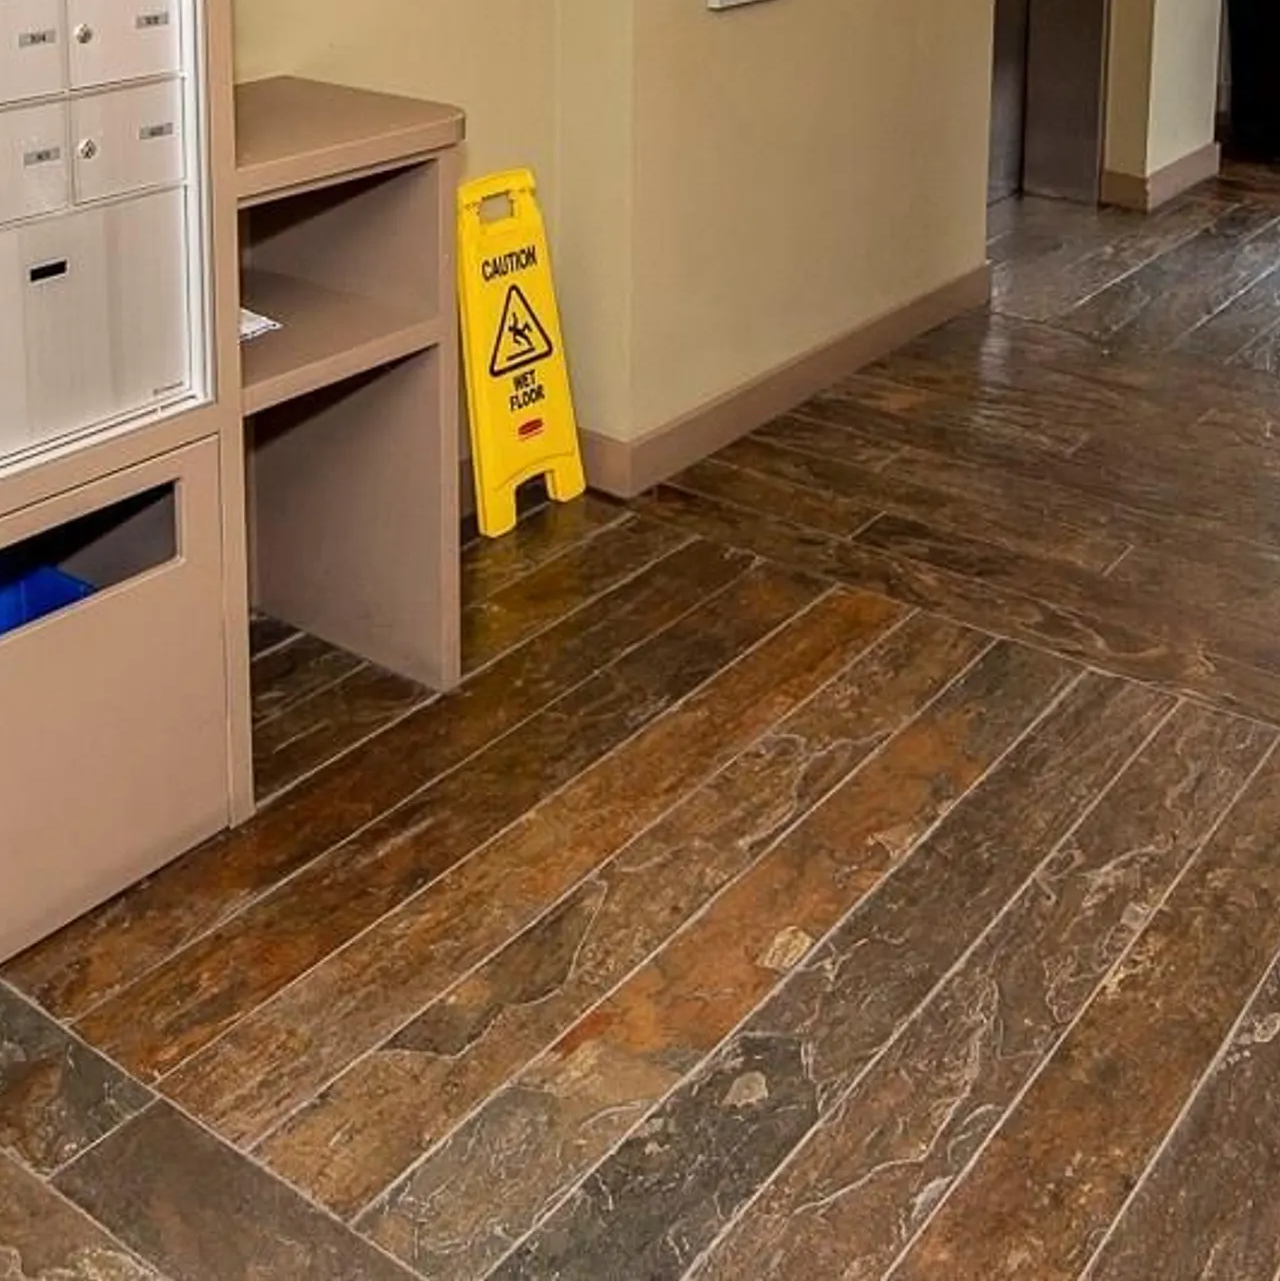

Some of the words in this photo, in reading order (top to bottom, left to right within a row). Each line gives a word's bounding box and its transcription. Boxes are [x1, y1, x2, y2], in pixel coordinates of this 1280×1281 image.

[482, 244, 538, 282] CAUTION
[513, 369, 536, 391] WET
[510, 384, 545, 412] FLOOR
